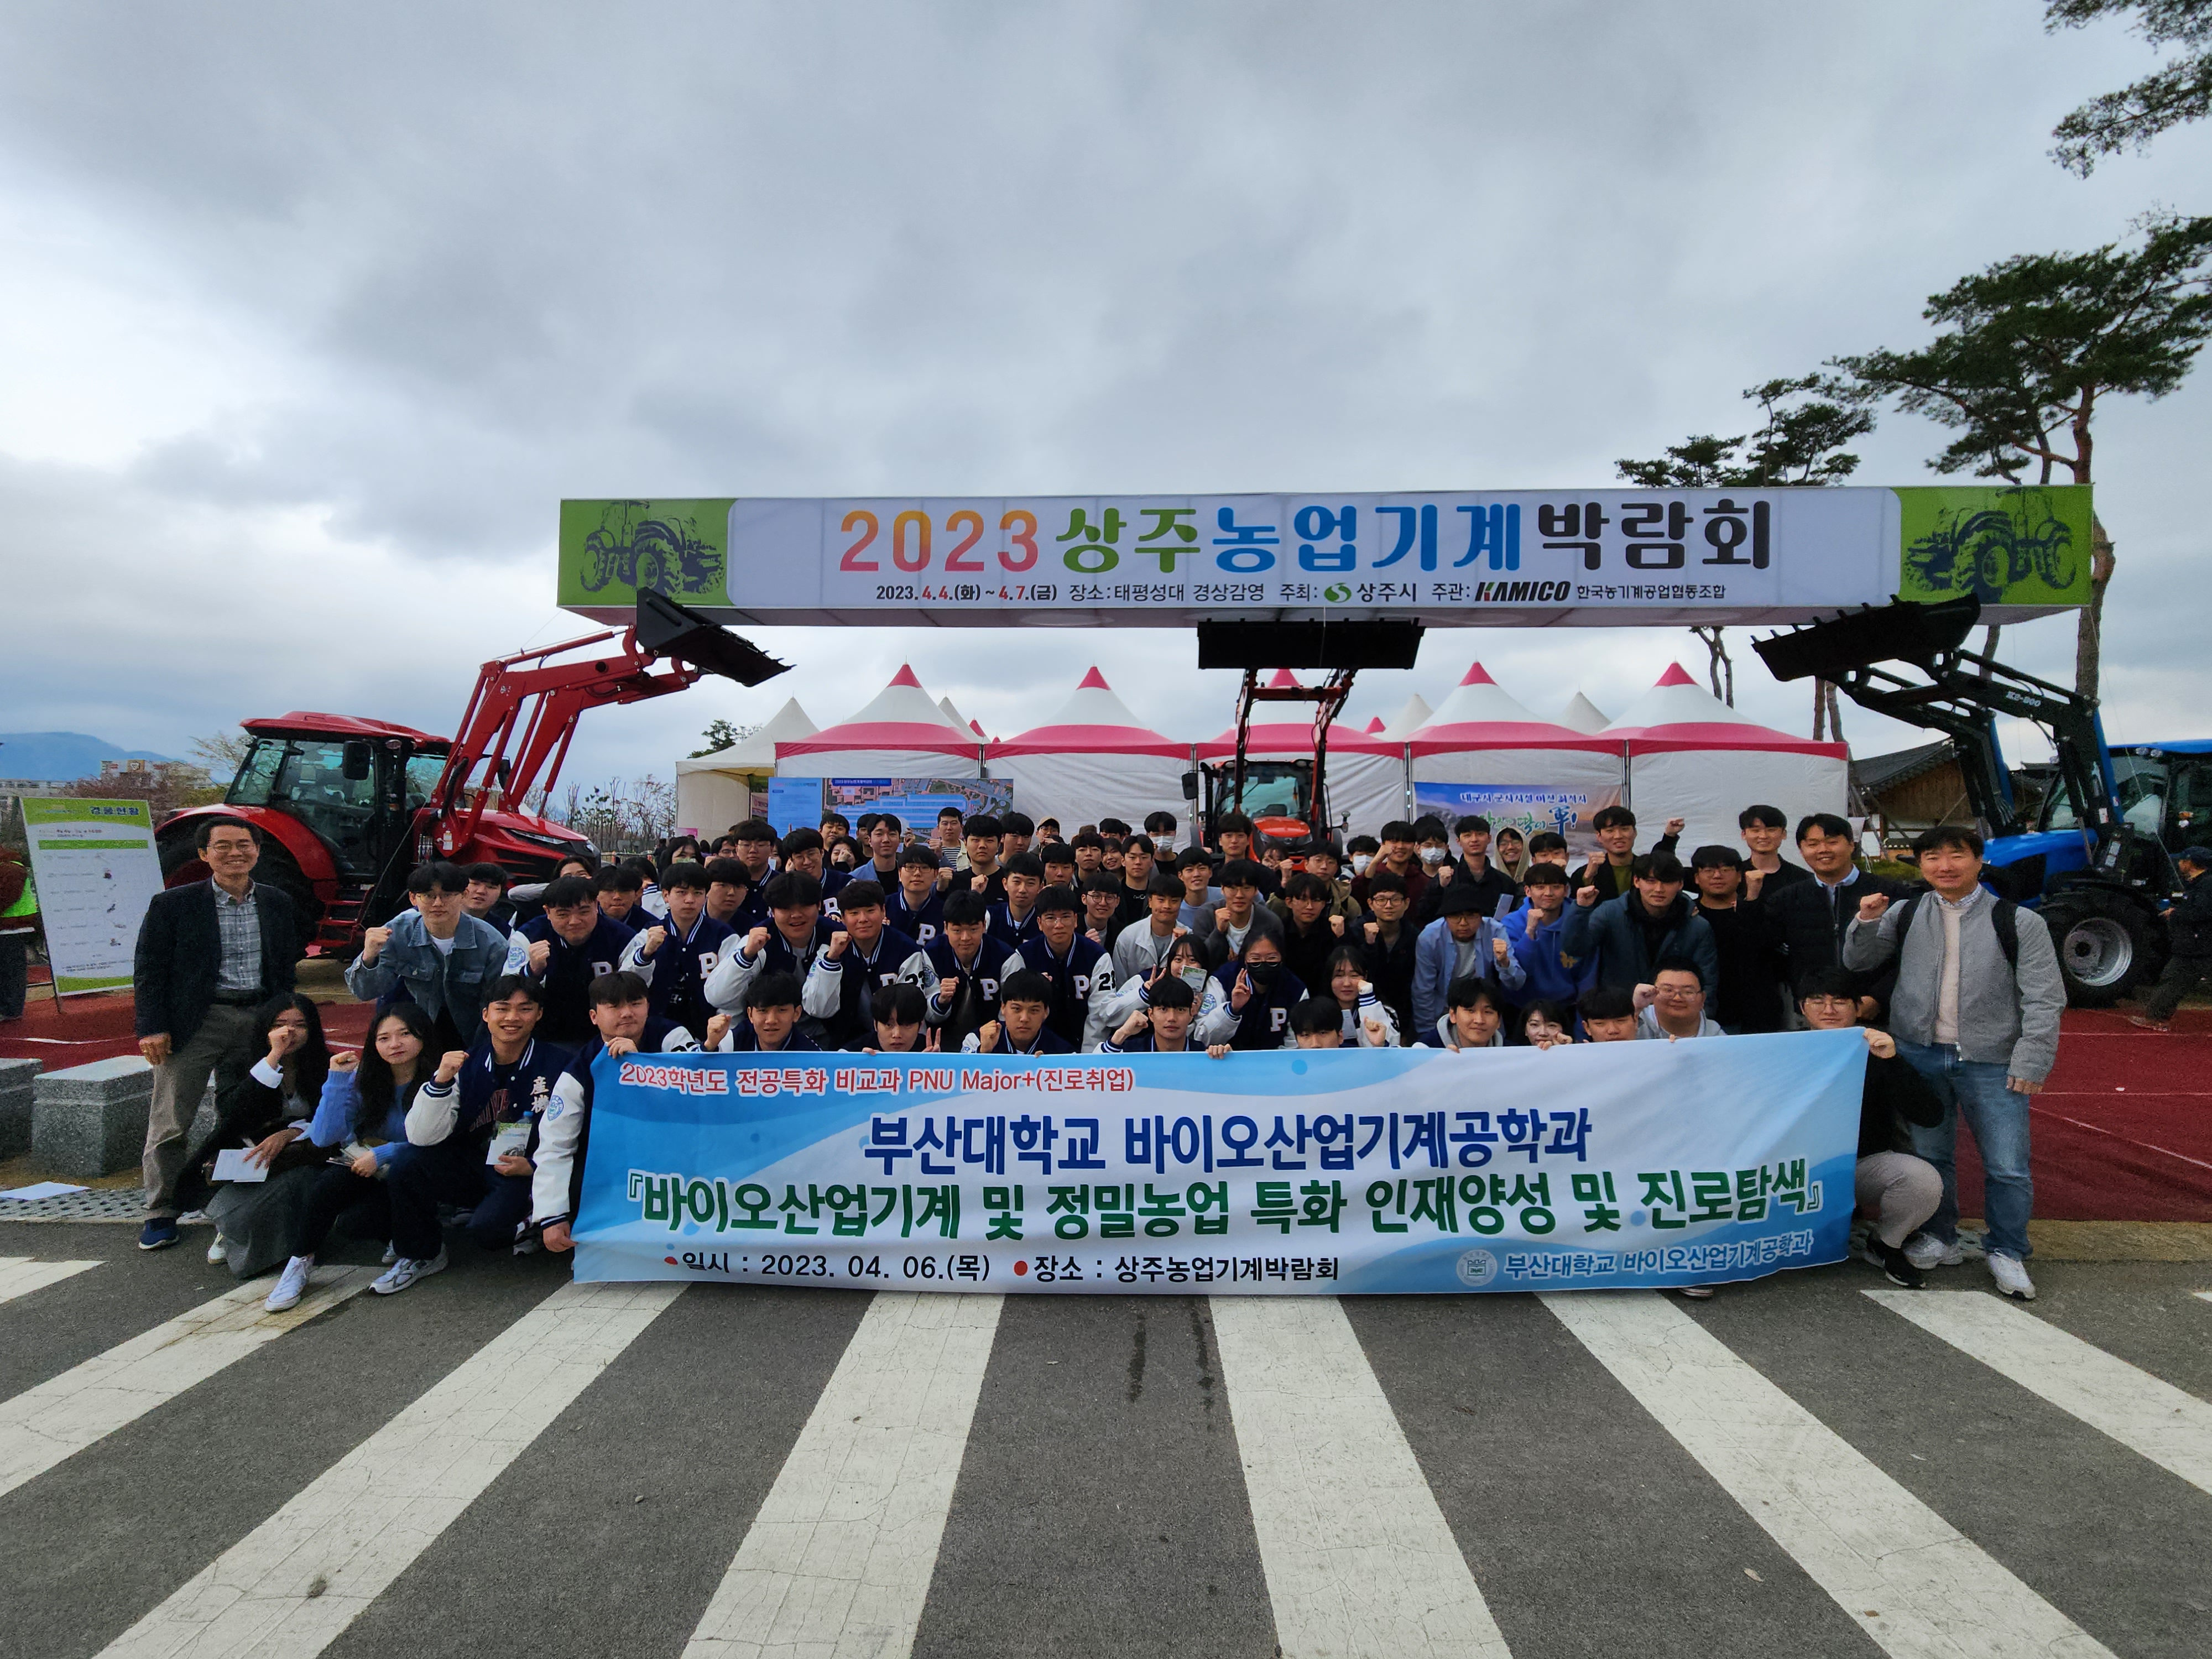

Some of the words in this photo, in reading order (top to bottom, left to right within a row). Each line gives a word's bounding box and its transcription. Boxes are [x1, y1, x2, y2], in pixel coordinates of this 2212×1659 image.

[840, 510, 1039, 572] 2023
[1193, 583, 1264, 601] 경상감영
[1280, 583, 1317, 602] 주최:
[1357, 583, 1417, 602] 상주시
[1475, 581, 1571, 602] KAMICO
[1577, 585, 1726, 599] 한국농기계공업협동조합
[916, 923, 936, 946] P
[699, 951, 719, 980] P
[979, 978, 999, 1001] P
[1073, 974, 1090, 1000] P
[1270, 1007, 1287, 1032] P
[621, 1063, 728, 1093] 2023학년도
[737, 1069, 827, 1094] 전공특화
[837, 1070, 900, 1093] 비교과
[910, 1070, 953, 1091] PNU
[963, 1069, 1134, 1092] Major+(진로취업)
[864, 1114, 1106, 1175] 부산대학교
[1125, 1108, 1593, 1174] 바이오산업기계공학과
[982, 1184, 1024, 1241] 및
[1046, 1181, 1229, 1240] 정밀농업
[1250, 1179, 1348, 1234] 특화
[1365, 1171, 1556, 1235] 인재양성
[1571, 1171, 1621, 1232] 및
[1637, 1158, 1822, 1229] 진로탐색』
[682, 1251, 729, 1271] 일시
[761, 1254, 836, 1278] 2023.
[848, 1255, 890, 1278] 04.
[902, 1254, 990, 1282] 06.(목)
[1034, 1255, 1084, 1282] 장소
[1114, 1256, 1339, 1283] 상주농업기계박람회
[1505, 1254, 1615, 1278] 부산대학교
[1624, 1231, 1812, 1273] 바이오산업기계공학과
